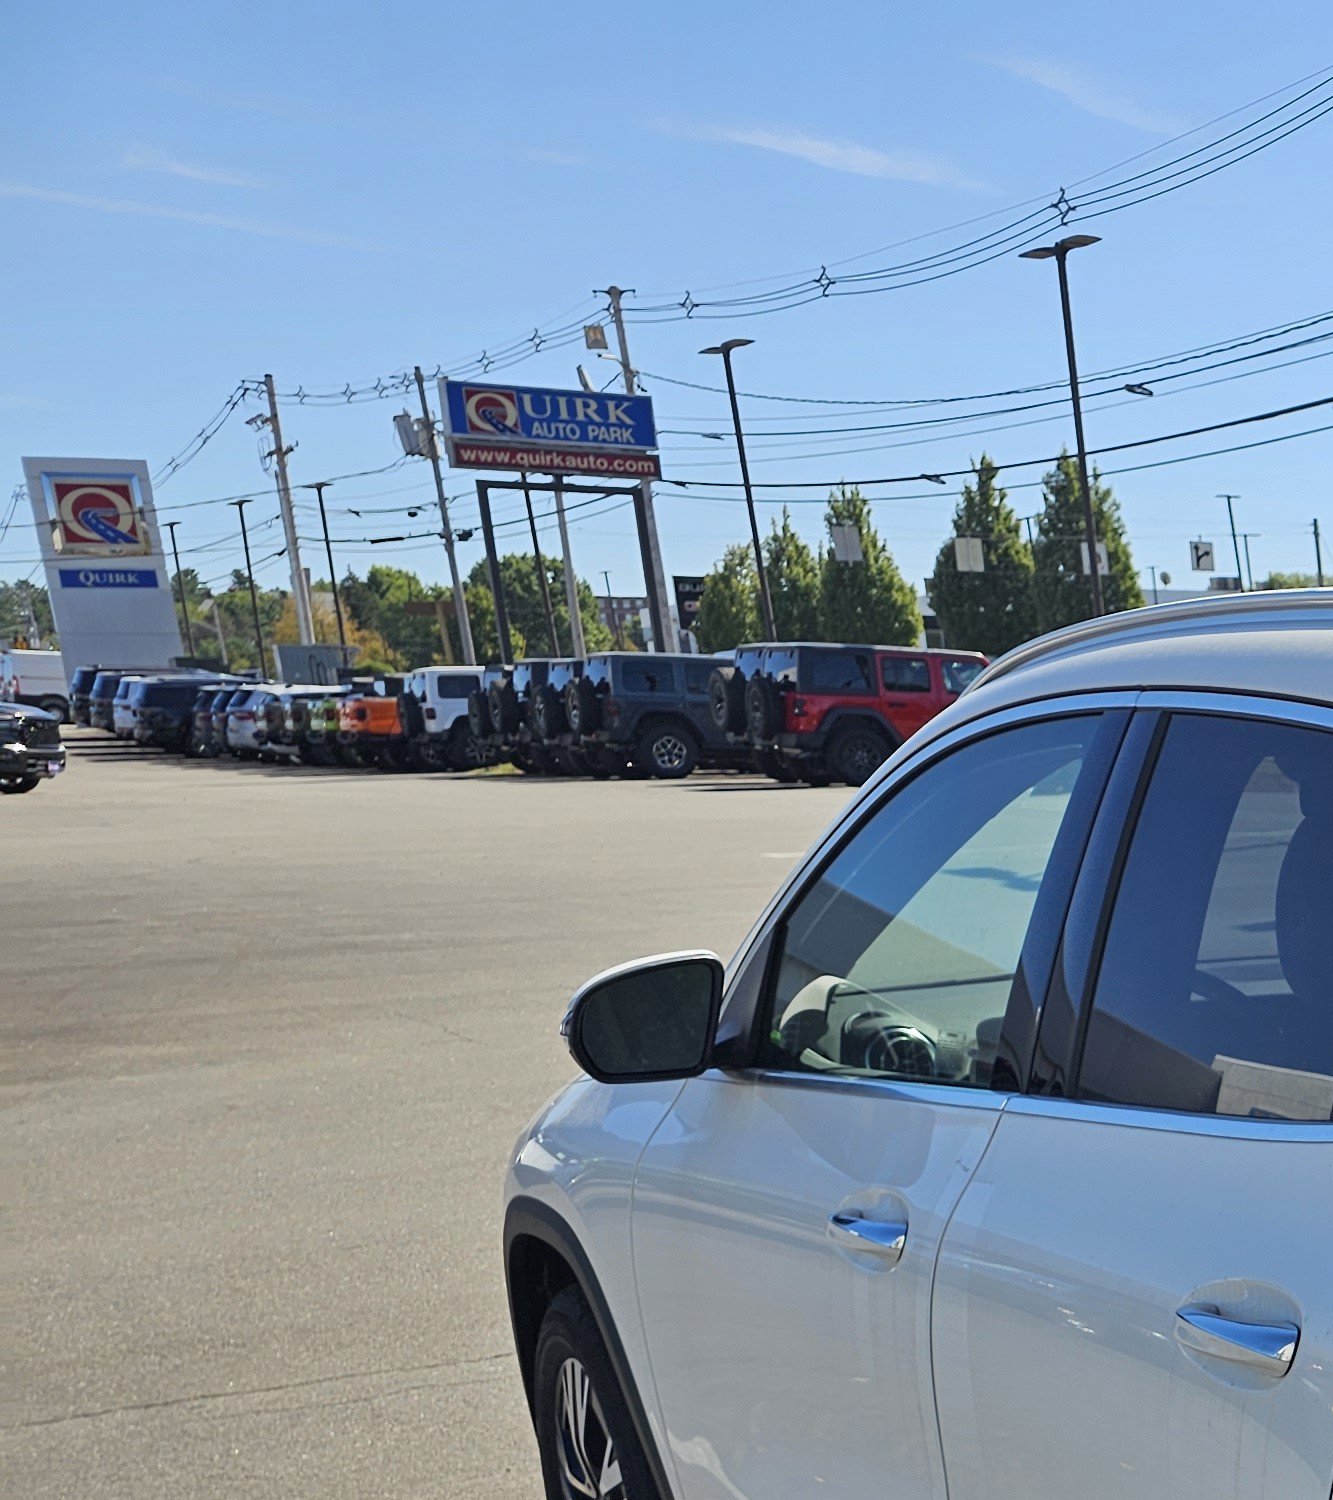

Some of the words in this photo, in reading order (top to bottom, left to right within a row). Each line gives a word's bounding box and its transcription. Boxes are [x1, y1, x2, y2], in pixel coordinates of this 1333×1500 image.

[531, 420, 581, 441] AUTO
[587, 424, 636, 444] PARK
[460, 448, 655, 473] www.quirkauto.com
[78, 570, 140, 588] QUIRK
